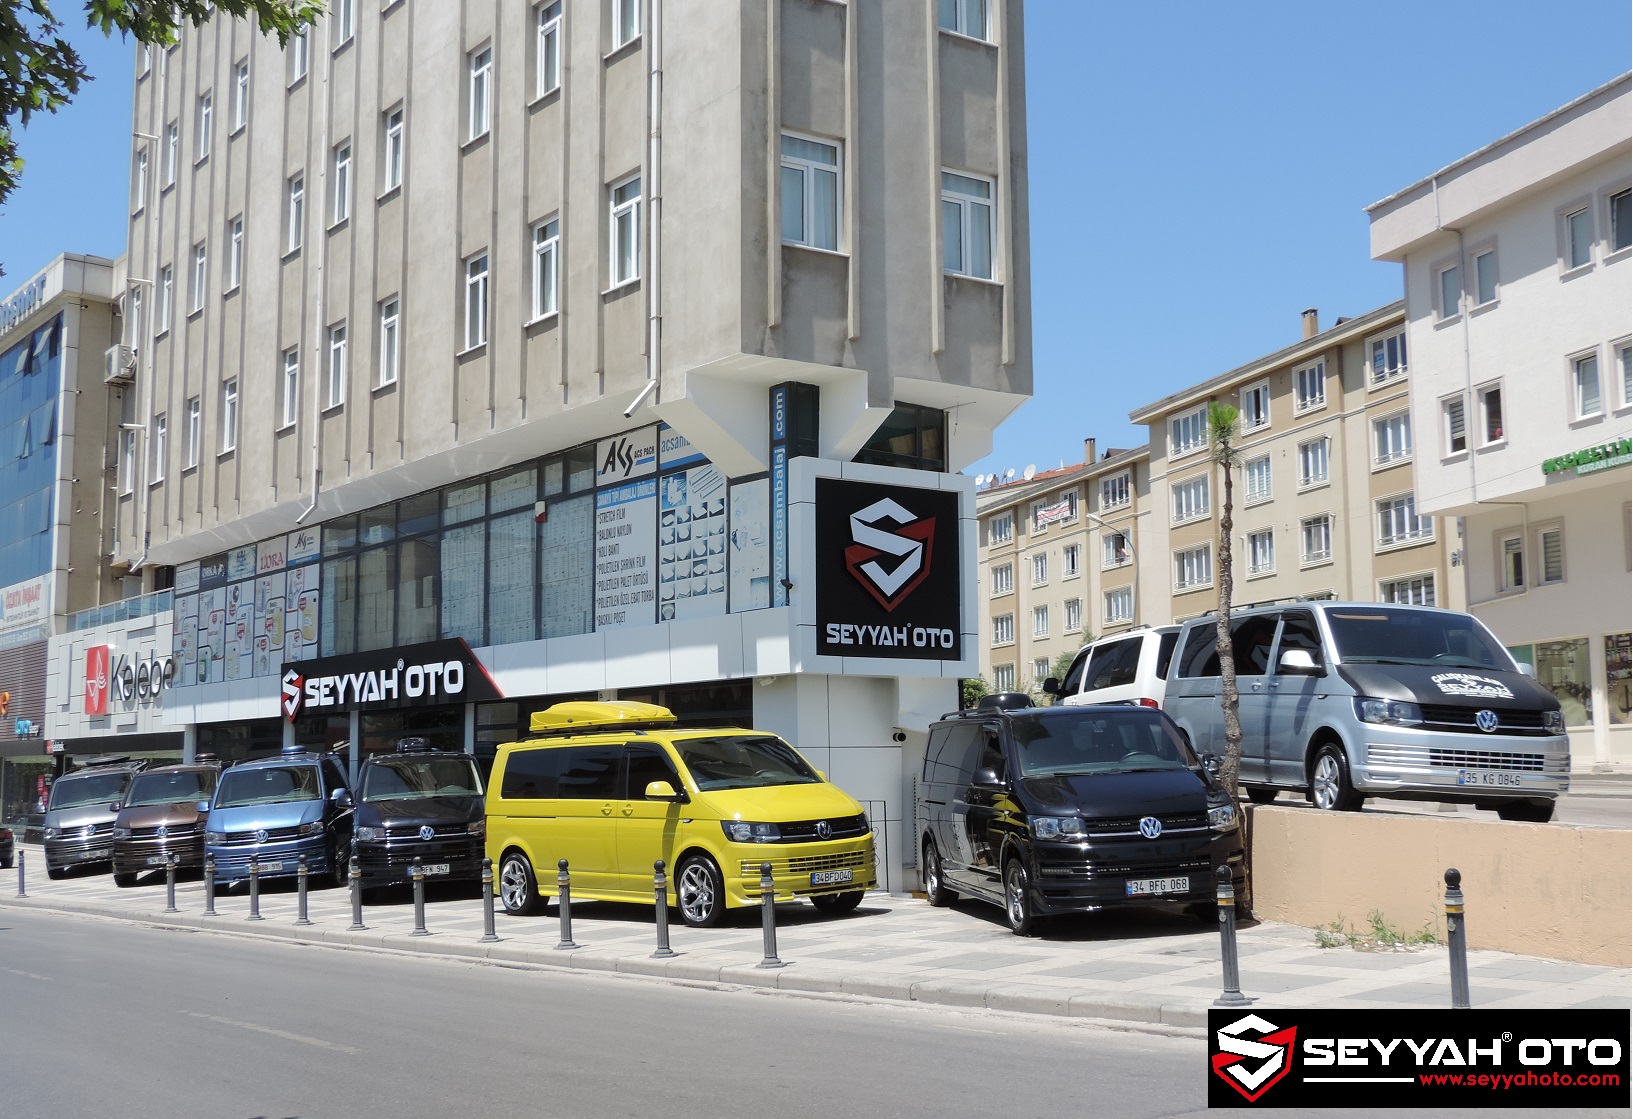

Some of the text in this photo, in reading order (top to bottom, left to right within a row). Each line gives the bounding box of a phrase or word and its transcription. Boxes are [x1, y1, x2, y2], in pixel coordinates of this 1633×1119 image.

[775, 392, 783, 435] .com
[661, 435, 691, 453] acsam
[912, 627, 954, 648] OTO
[405, 660, 464, 698] OTO
[1465, 772, 1521, 786] 35 KG 0846
[436, 864, 448, 873] 947
[1133, 878, 1187, 892] 34 BFG 068
